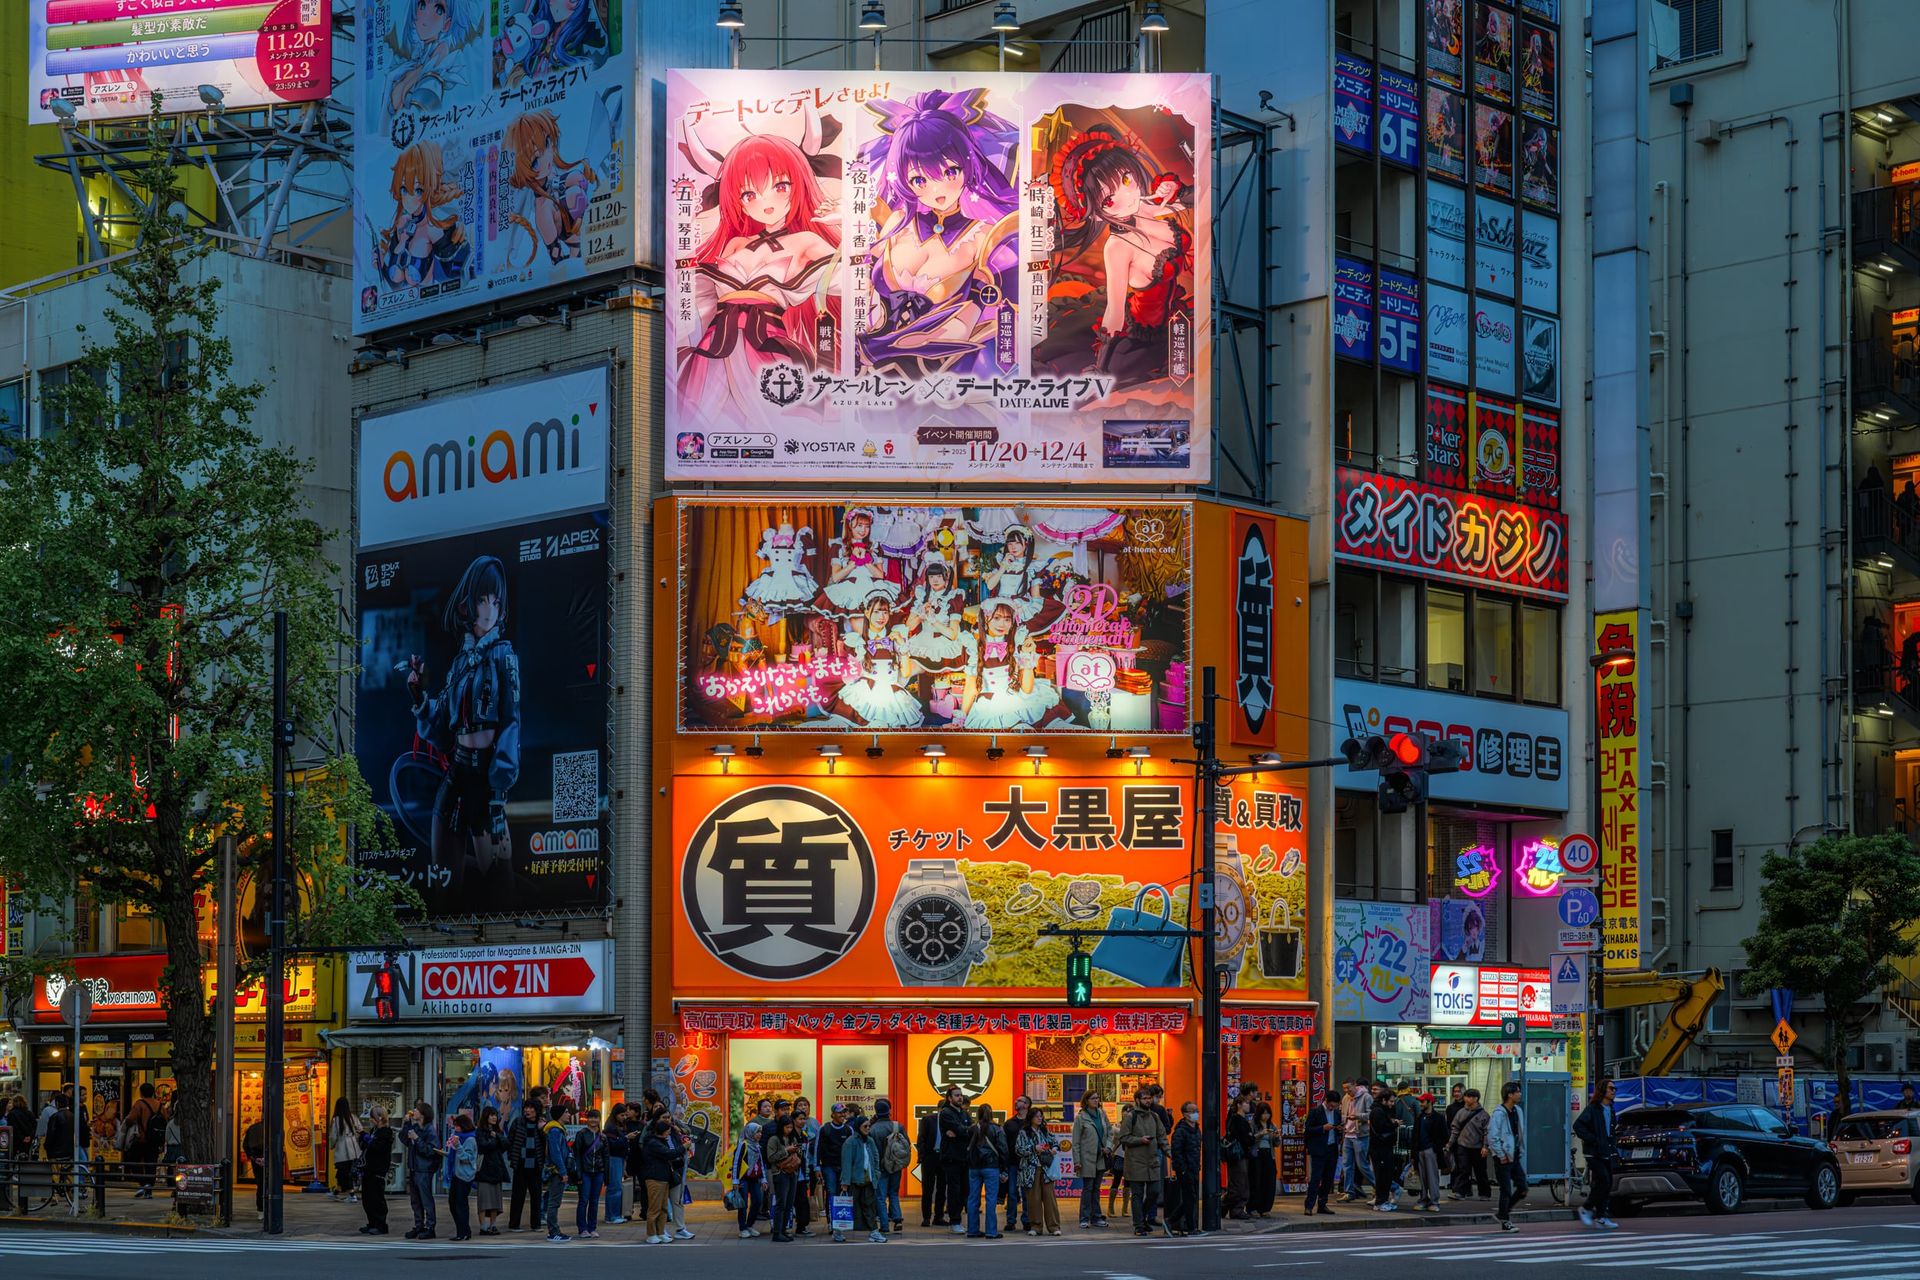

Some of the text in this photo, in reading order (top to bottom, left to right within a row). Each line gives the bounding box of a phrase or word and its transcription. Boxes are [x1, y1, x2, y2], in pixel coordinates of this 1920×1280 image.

[130, 16, 208, 36] 髪型が素敵だ
[126, 43, 211, 63] かわいいと思う
[269, 49, 316, 60] メンテナンス後
[273, 62, 311, 80] 12.3
[94, 85, 121, 93] アズレン
[275, 82, 310, 91] 23:59まで
[687, 82, 891, 127] デートしてデレさせよ!
[418, 105, 477, 141] アズールレーン
[1380, 113, 1417, 159] 6F
[588, 233, 613, 255] 12.4
[680, 259, 692, 268] CV
[854, 255, 868, 264] CV
[1032, 262, 1045, 270] CV
[495, 274, 518, 286] YOSTAR
[381, 292, 405, 306] アズレン
[680, 270, 692, 321] 竹達彩奈
[820, 326, 832, 352] 戦艦
[1000, 312, 1012, 363] 重巡洋艦
[1380, 315, 1417, 362] 5F
[1173, 323, 1186, 376] 軽巡洋艦
[809, 374, 1113, 401] アズールレーン デート・ア・ライブV
[713, 436, 752, 446] アズレン
[923, 430, 992, 440] イベント開催期間
[802, 442, 855, 452] YOSTAR
[1041, 441, 1087, 462] 12/4
[1427, 442, 1460, 467] Stars
[383, 414, 580, 502] amiami
[1142, 522, 1157, 534] at
[1342, 483, 1561, 583] メイドカジノ
[520, 528, 600, 554] EZ APEX
[1158, 545, 1176, 554] cafe
[520, 553, 541, 562] STUDIO
[1074, 587, 1108, 621] 21
[1080, 661, 1100, 677] at
[1598, 624, 1636, 738] 免税
[753, 684, 829, 715] これからも。
[984, 785, 1184, 851] 大黒屋
[1618, 748, 1637, 908] TAX FREE
[531, 829, 599, 854] amiami
[888, 828, 972, 851] チケット
[1535, 848, 1563, 873] 22
[1567, 845, 1589, 862] 40
[531, 857, 598, 875] 好評予約受付中!
[707, 815, 857, 955] 質
[1567, 898, 1582, 924] P
[1577, 912, 1590, 924] 60
[1602, 933, 1638, 945] KIHABARA
[421, 943, 581, 960] Professional Support for Magazine & MANGA-ZIN
[1379, 935, 1407, 973] 22
[1604, 949, 1638, 960] OKiS
[1338, 960, 1353, 979] 2F
[1370, 966, 1410, 992] カレー
[424, 963, 549, 997] COMIC ZIN
[109, 989, 157, 1005] YOSHINOYA
[1434, 993, 1473, 1010] TOKiS
[422, 1000, 492, 1015] Akihabara
[684, 1011, 755, 1030] 高価買取
[1114, 1012, 1184, 1031] 無料査定
[1234, 1014, 1313, 1031] 1階にて高価買取中
[937, 1046, 985, 1095] 質
[1312, 1053, 1328, 1068] 4F
[836, 1077, 876, 1090] 大黒屋
